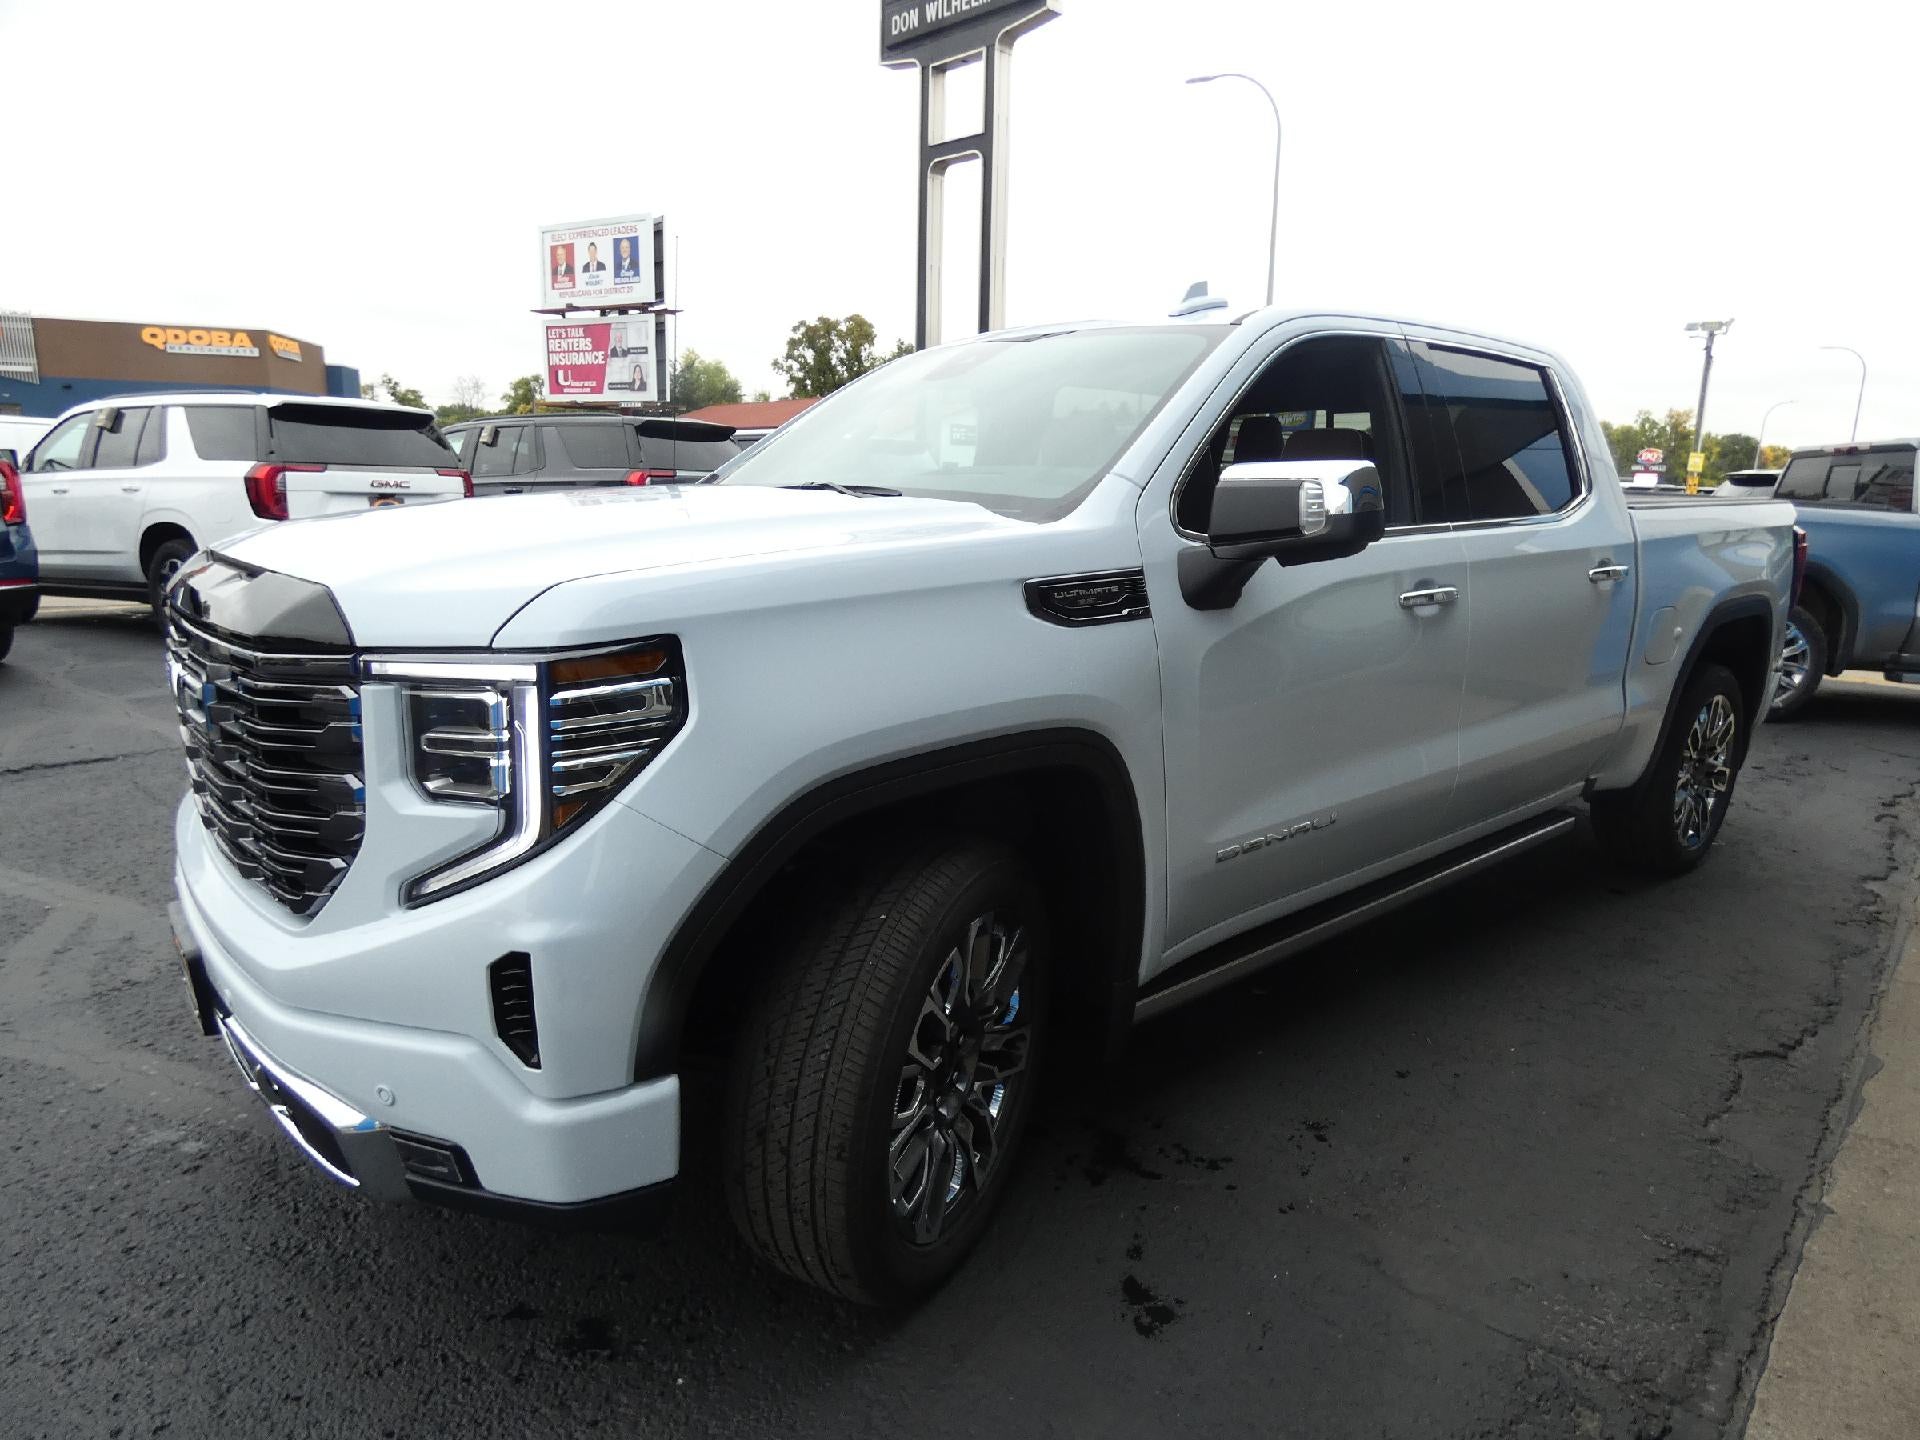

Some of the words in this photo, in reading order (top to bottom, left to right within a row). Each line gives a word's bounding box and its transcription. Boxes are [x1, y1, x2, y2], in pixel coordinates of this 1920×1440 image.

[891, 7, 919, 35] DON
[925, 0, 991, 23] WILHE
[568, 228, 609, 240] EXPERIENCED
[610, 225, 638, 236] LEADERS
[141, 326, 254, 350] QDOBA
[548, 328, 566, 338] LET'S
[566, 327, 584, 337] TALK
[548, 337, 592, 352] RENTERS
[549, 351, 606, 366] INSURANCE
[370, 480, 410, 488] GMC
[1054, 585, 1119, 599] ULTIMATE
[1215, 810, 1337, 863] DENALI
